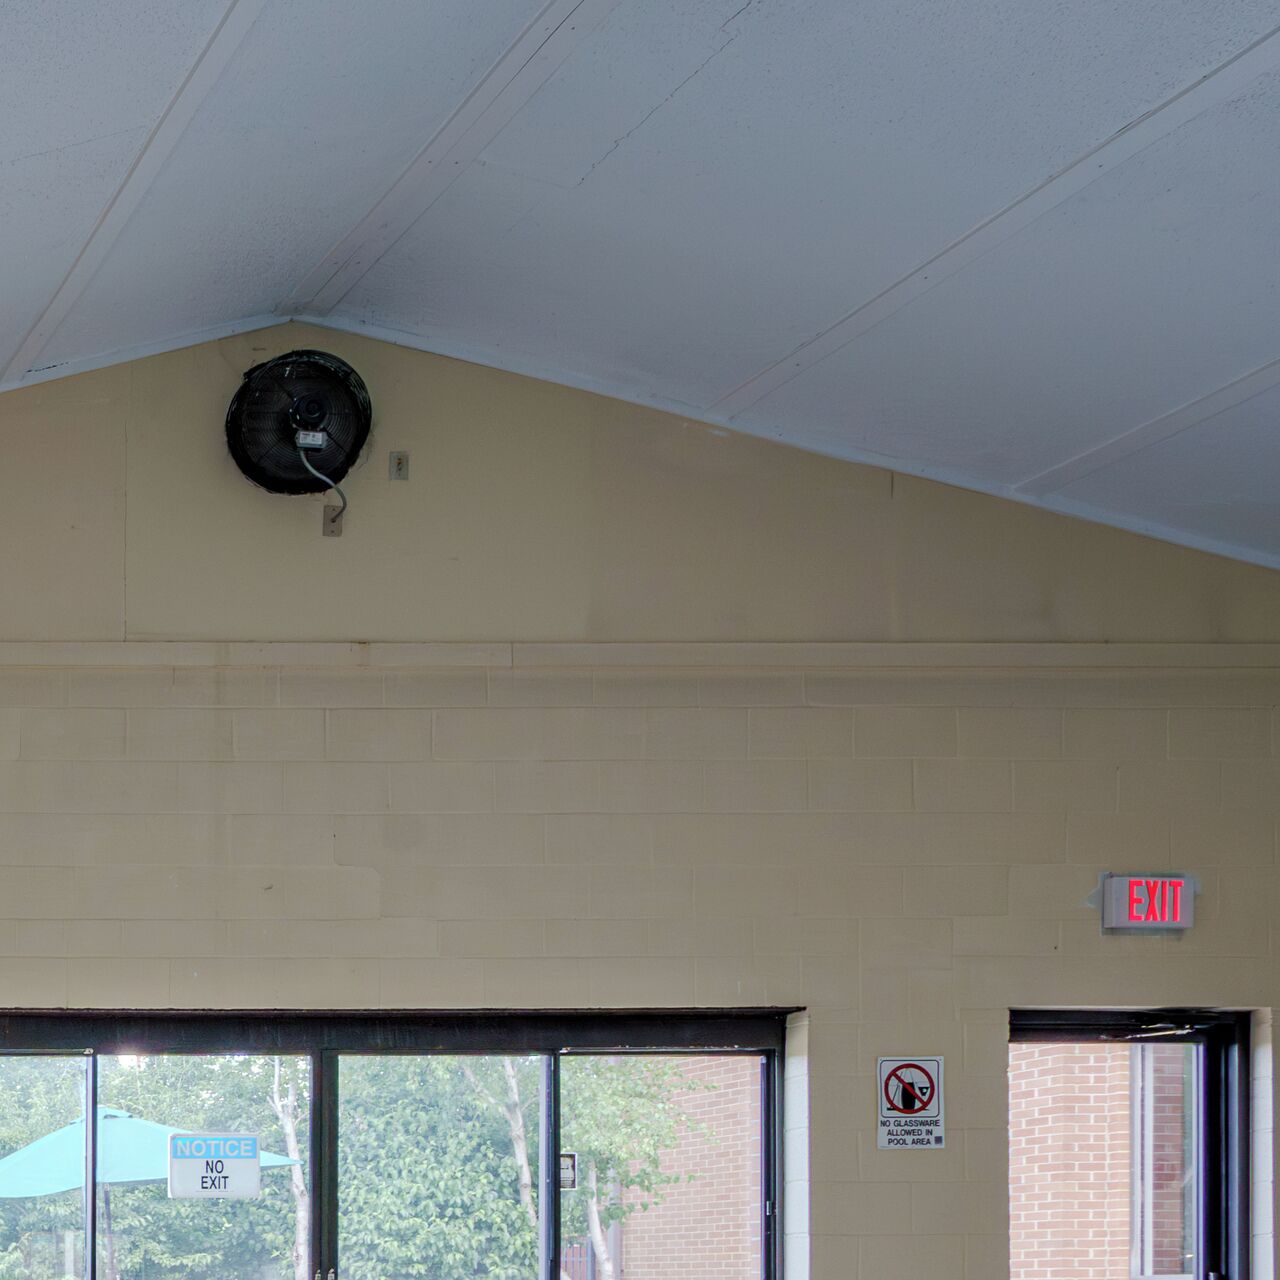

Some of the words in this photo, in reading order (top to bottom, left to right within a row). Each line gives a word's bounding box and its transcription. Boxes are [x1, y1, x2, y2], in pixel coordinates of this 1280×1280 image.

[1128, 879, 1184, 922] EXIT
[893, 1119, 940, 1127] GLASSWARE
[176, 1140, 253, 1157] NOTICE
[205, 1160, 224, 1173] NO
[201, 1176, 229, 1189] EXIT
